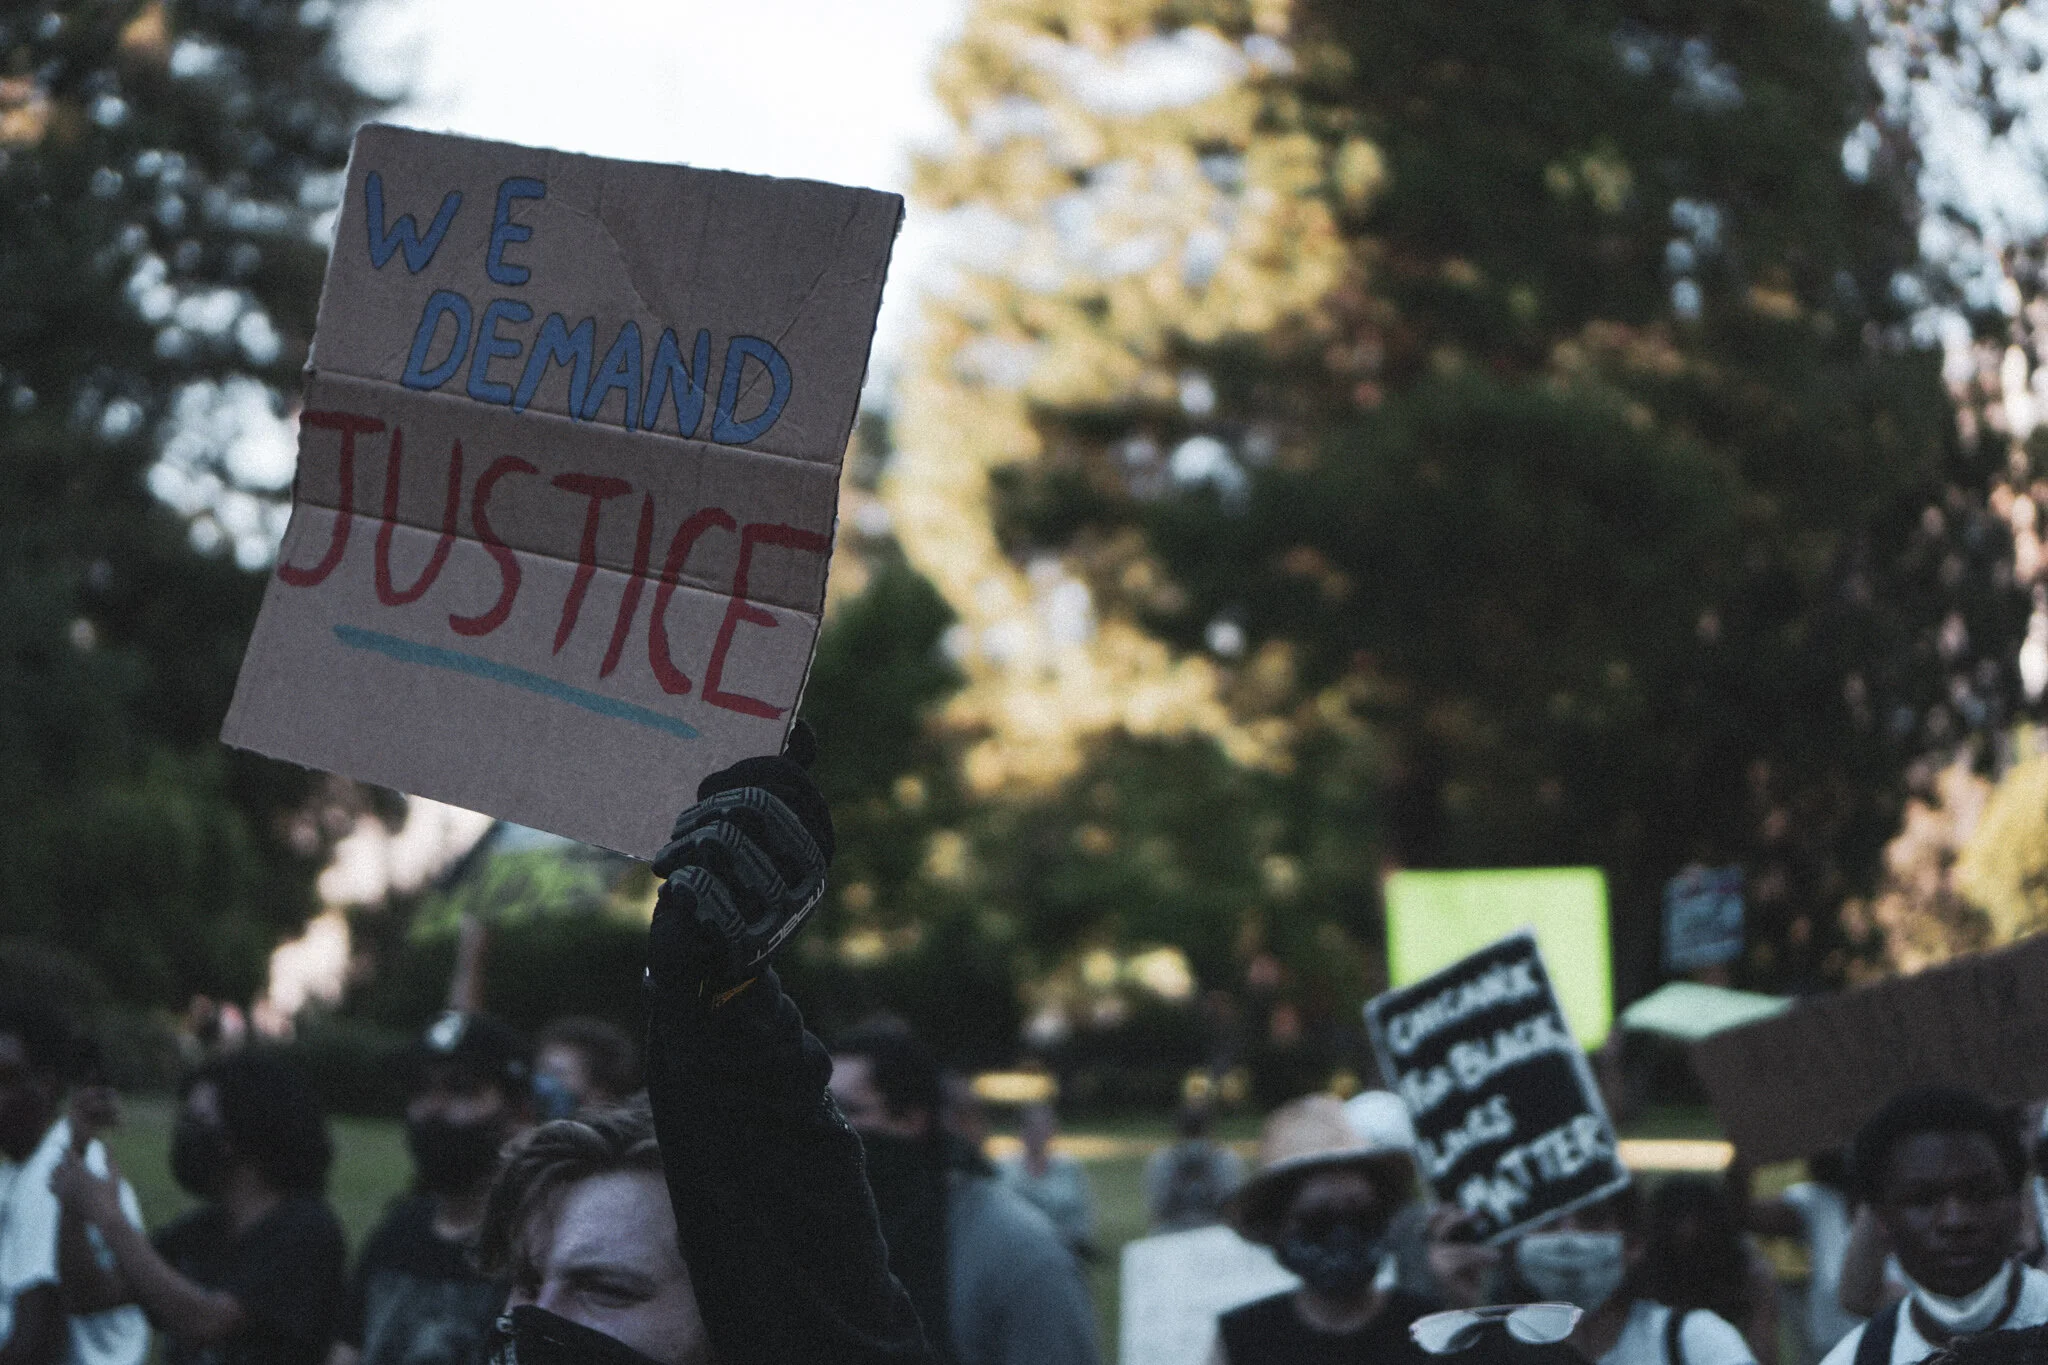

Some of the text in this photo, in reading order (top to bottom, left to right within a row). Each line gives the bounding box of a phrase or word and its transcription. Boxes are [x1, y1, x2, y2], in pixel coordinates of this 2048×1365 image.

[364, 169, 548, 287] WE
[400, 289, 793, 446] DEMAND
[277, 409, 834, 720] JUSTICE
[1456, 1112, 1618, 1224] MATTER
